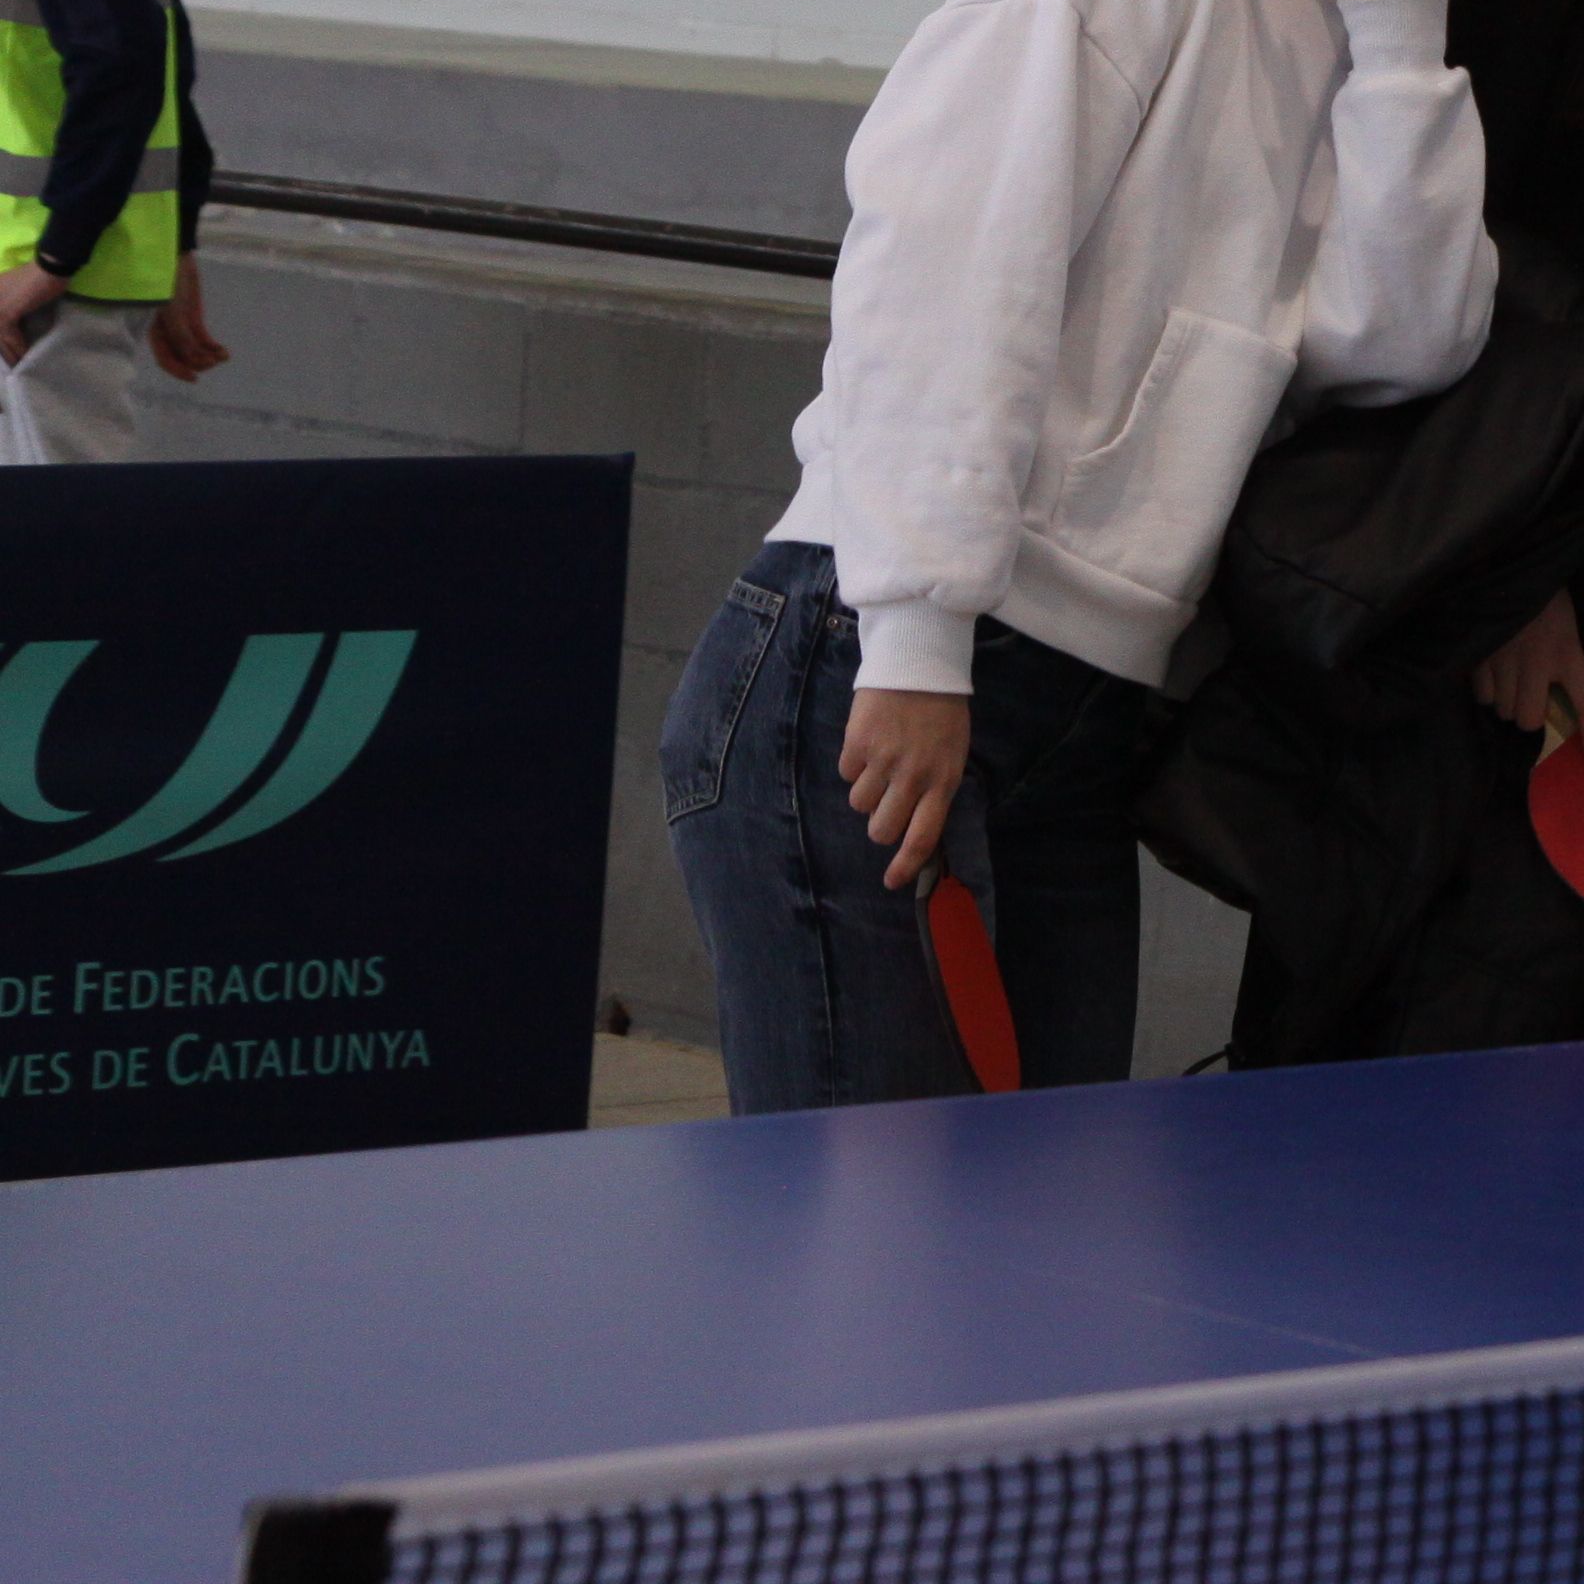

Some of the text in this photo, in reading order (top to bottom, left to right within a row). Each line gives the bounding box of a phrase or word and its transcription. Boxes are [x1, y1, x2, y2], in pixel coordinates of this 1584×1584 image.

[0, 955, 386, 1017] DE FEDERACIONS
[92, 1047, 150, 1091] DE
[166, 1028, 431, 1086] CATALUNYA
